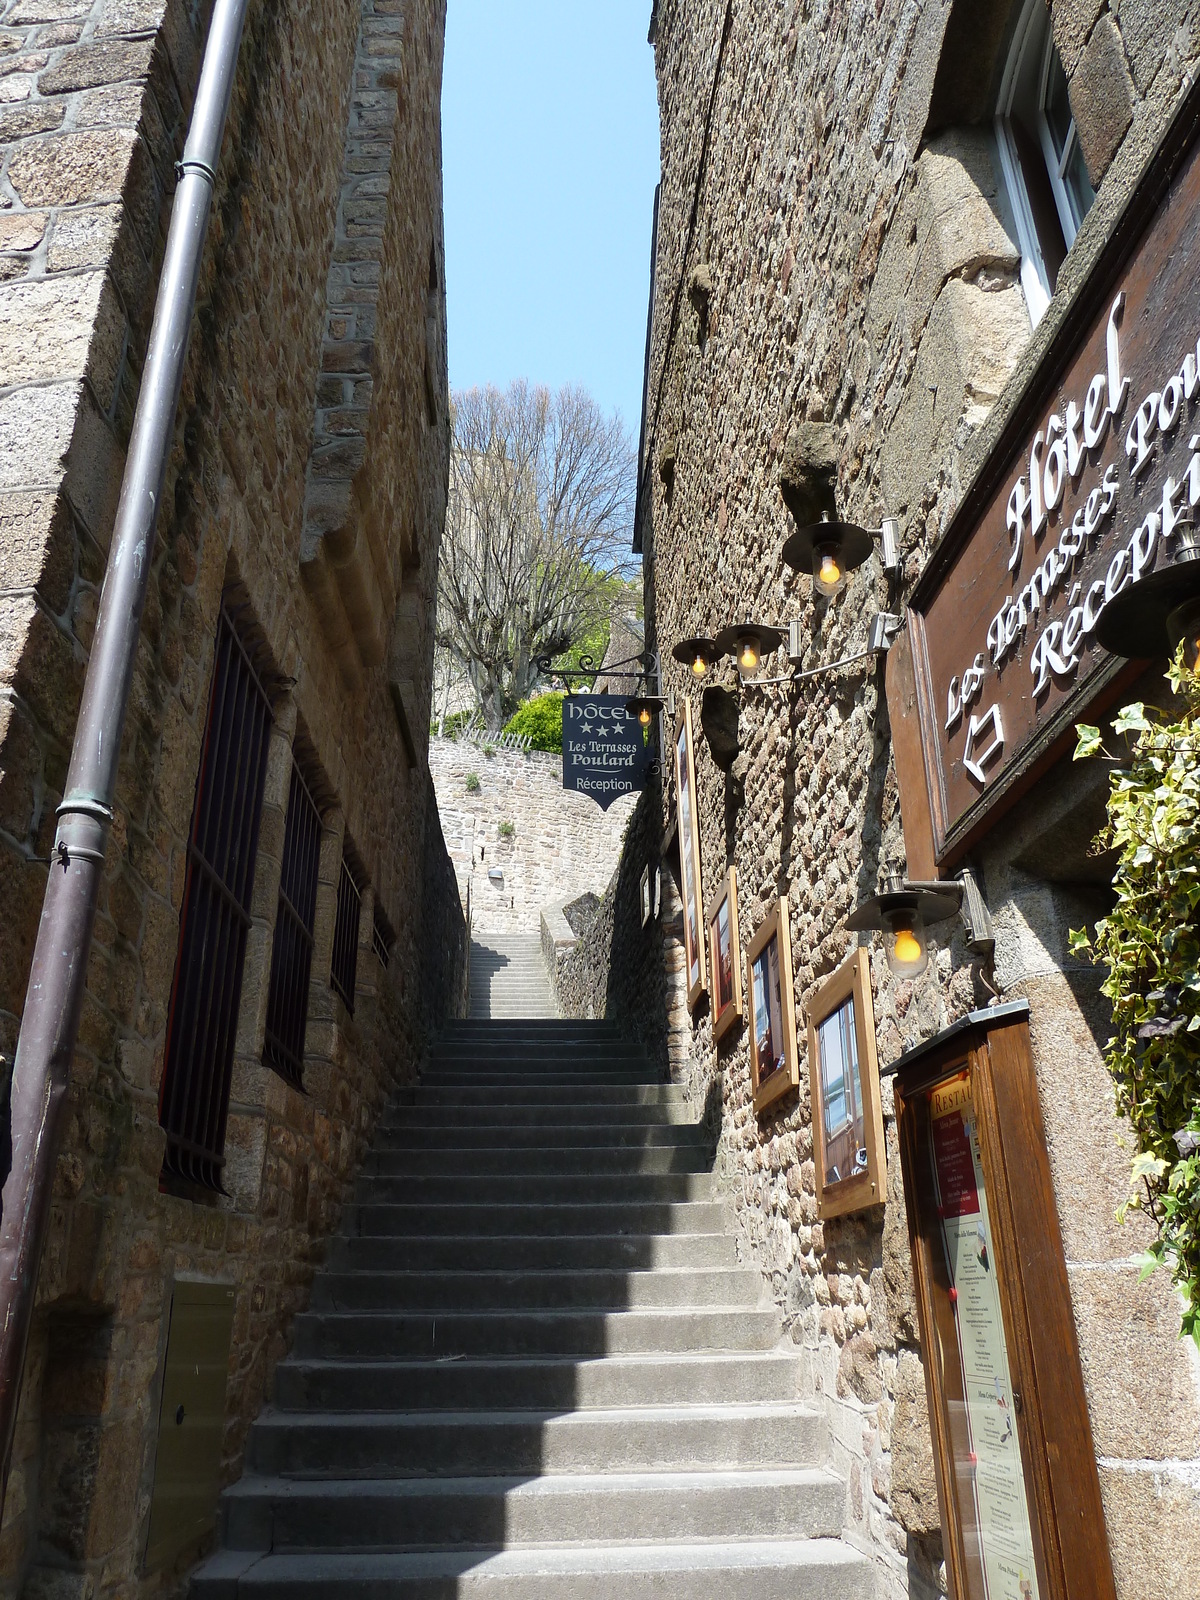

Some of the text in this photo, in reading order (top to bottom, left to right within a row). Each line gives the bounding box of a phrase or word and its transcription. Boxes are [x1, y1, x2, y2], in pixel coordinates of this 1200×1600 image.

[1006, 290, 1130, 571] Hôtel
[945, 653, 986, 730] Les
[987, 464, 1120, 665] Terrasses
[568, 740, 637, 754] Les Terrasses
[571, 753, 635, 767] Poulard
[576, 777, 633, 792] Réception
